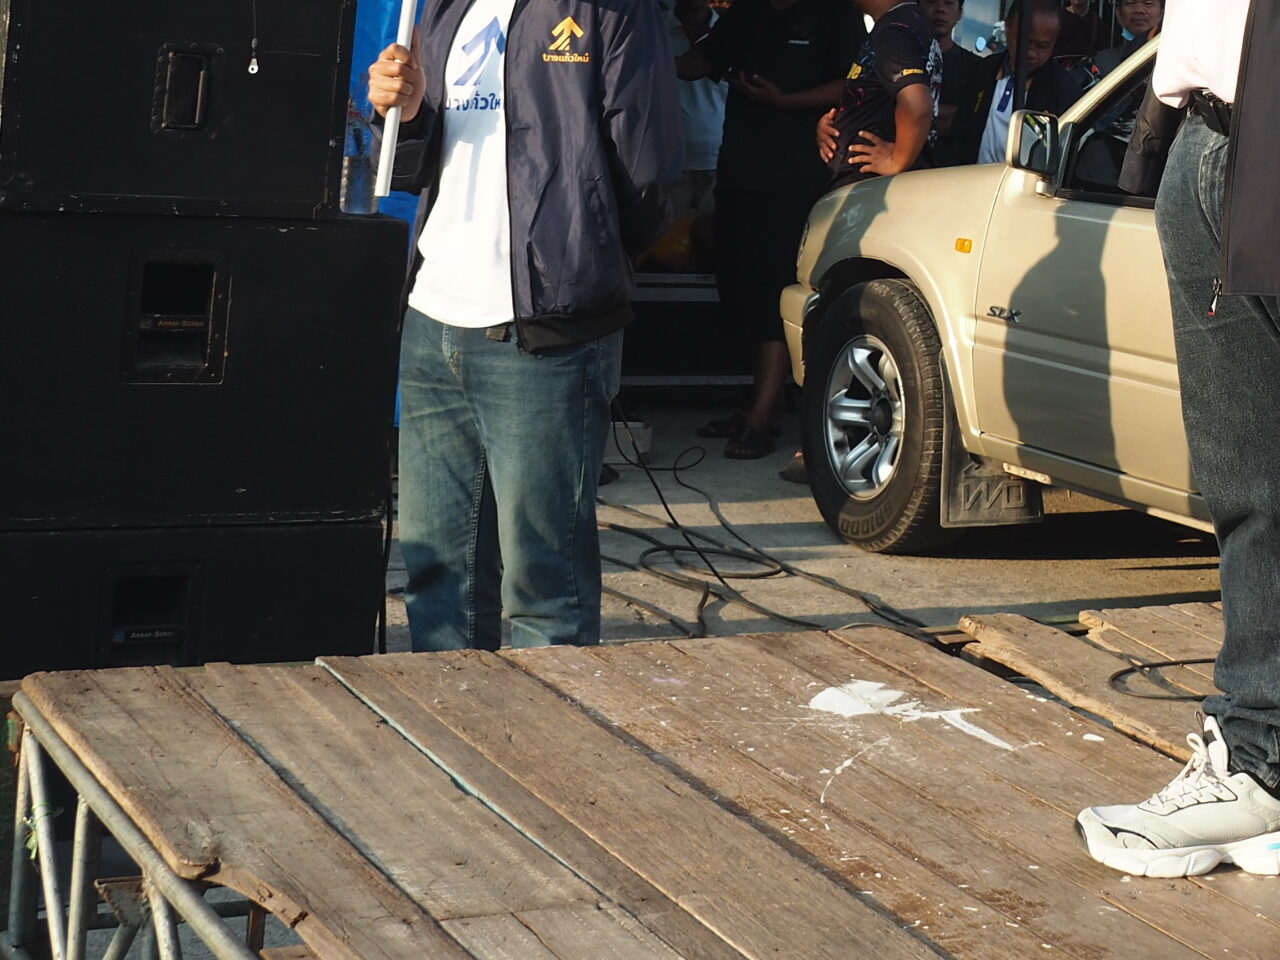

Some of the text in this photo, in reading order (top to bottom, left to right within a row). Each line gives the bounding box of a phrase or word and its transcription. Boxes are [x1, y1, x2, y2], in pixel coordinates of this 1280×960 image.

[542, 52, 590, 63] บางแก้วใหม่
[986, 306, 1023, 323] SLX
